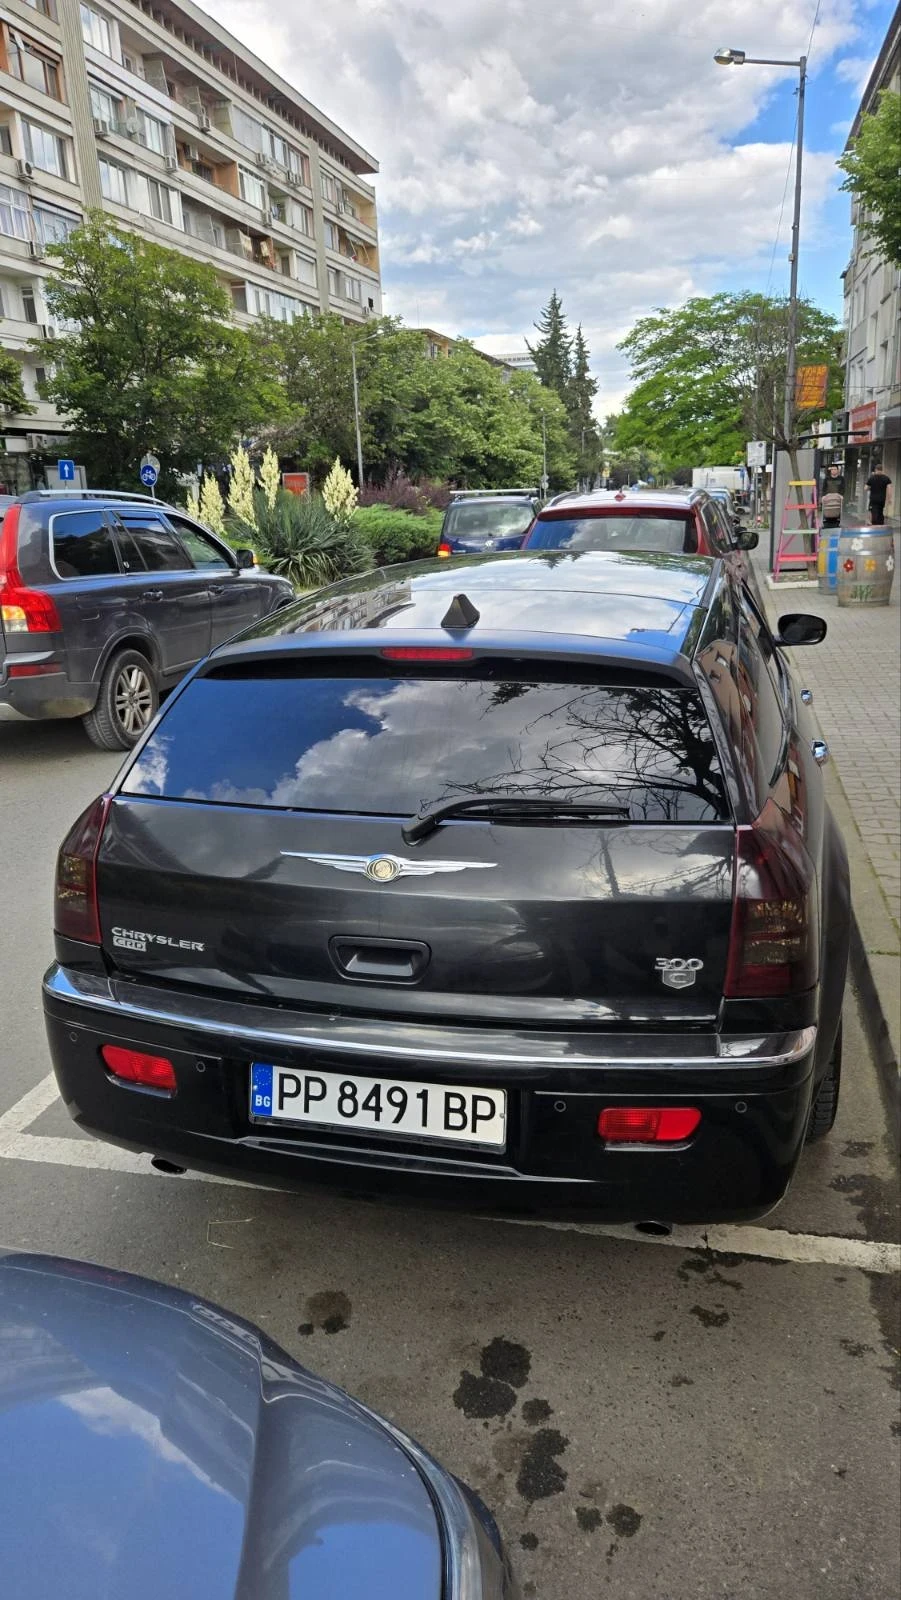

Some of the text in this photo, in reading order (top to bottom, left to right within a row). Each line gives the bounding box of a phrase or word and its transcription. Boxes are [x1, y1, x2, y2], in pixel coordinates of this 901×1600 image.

[112, 927, 205, 951] CHRYSLER
[114, 936, 146, 951] CRD
[654, 957, 704, 970] 300
[668, 973, 688, 984] C
[255, 1094, 271, 1107] BG
[278, 1072, 496, 1134] PP 8491 BP
